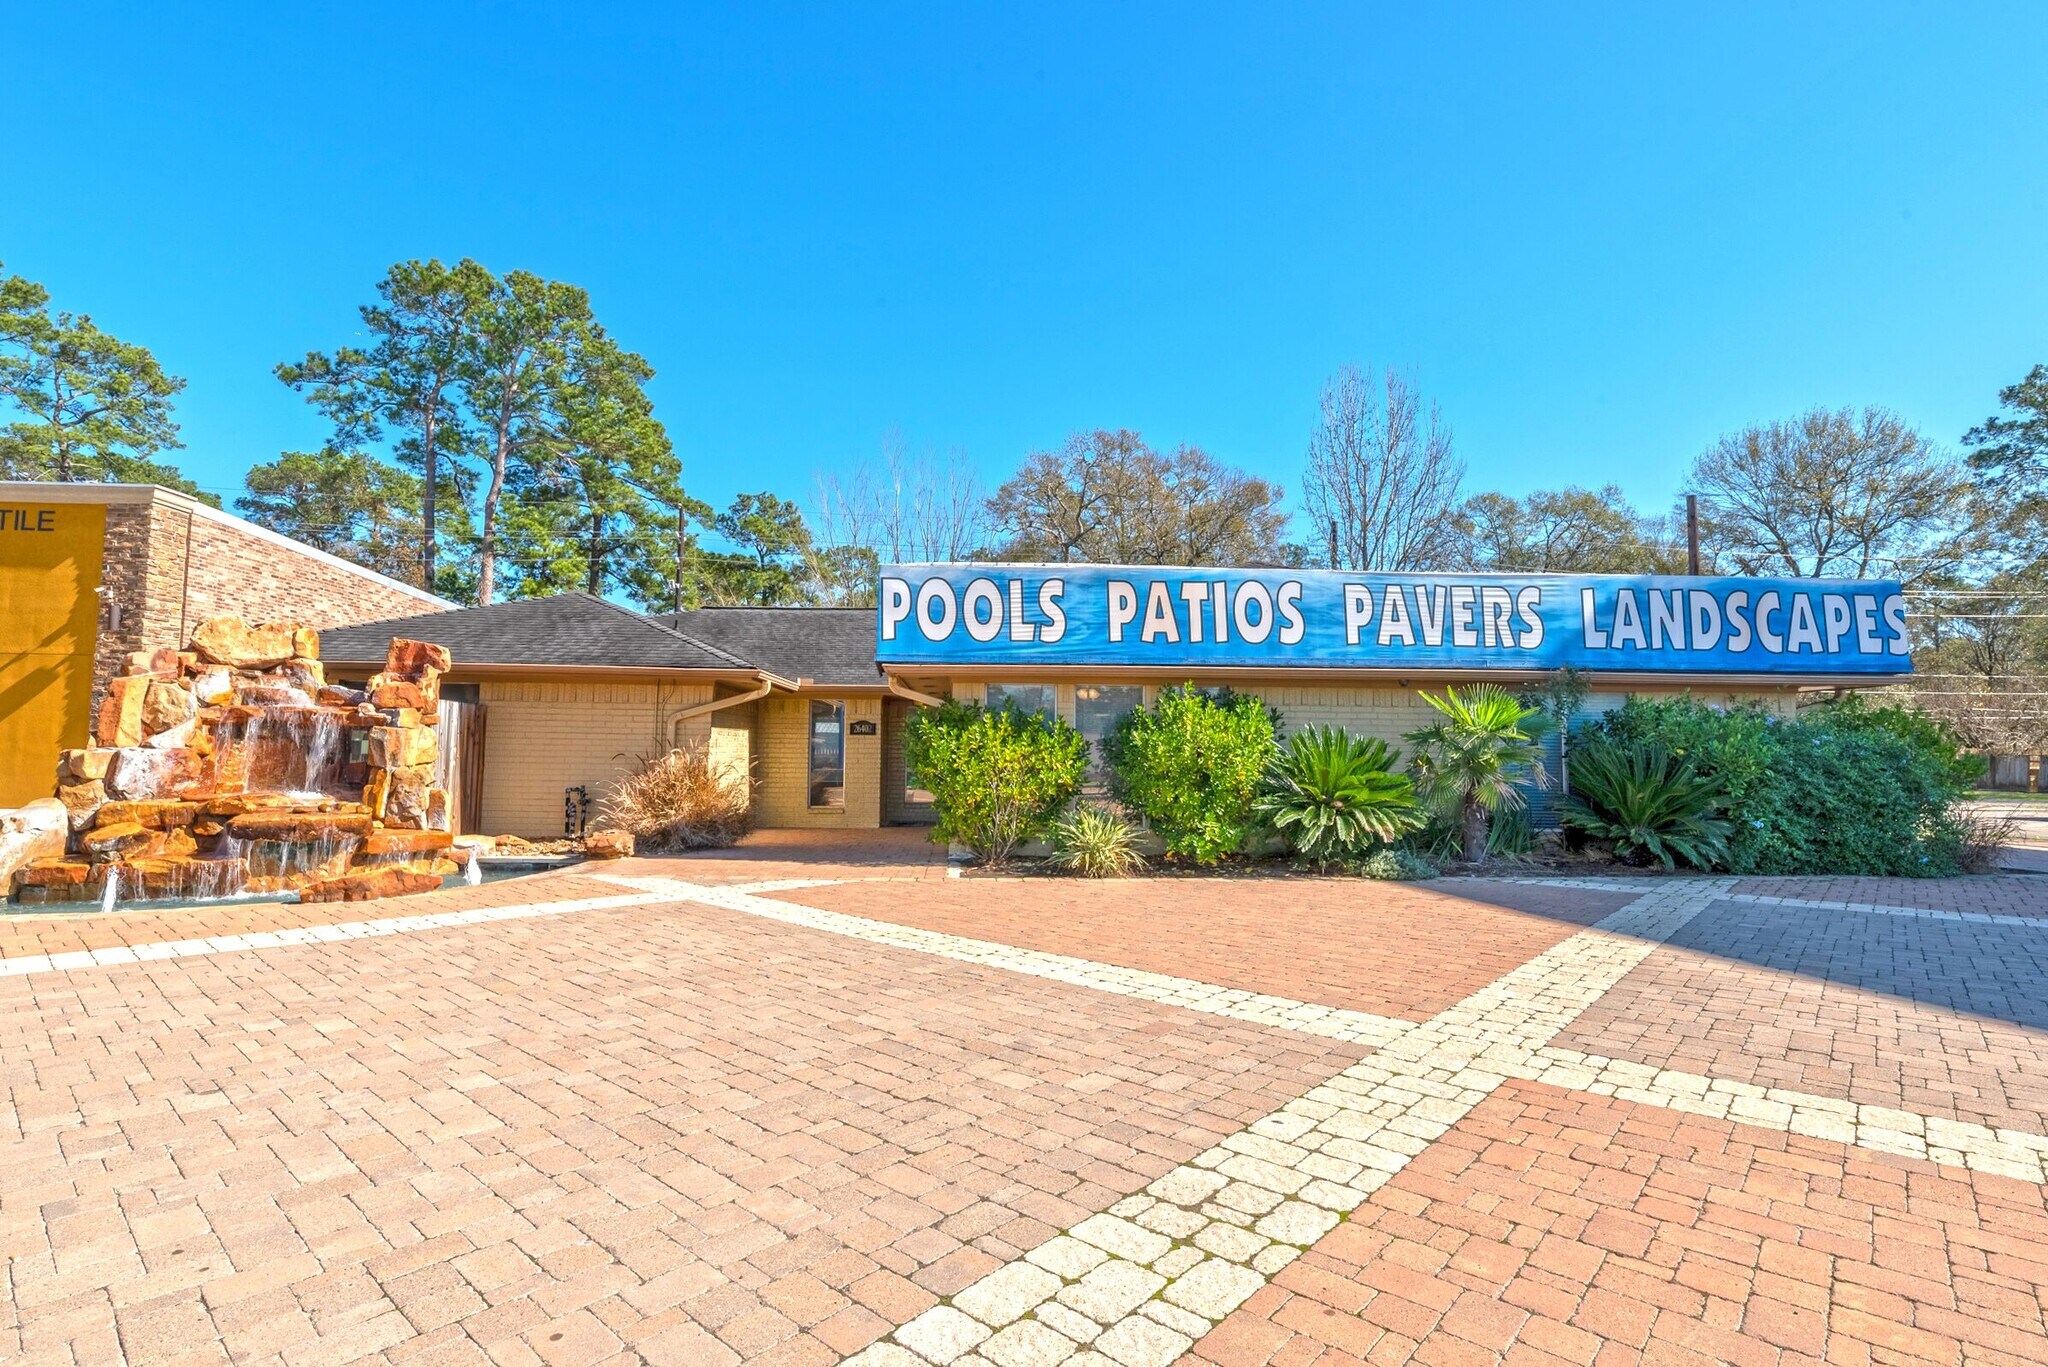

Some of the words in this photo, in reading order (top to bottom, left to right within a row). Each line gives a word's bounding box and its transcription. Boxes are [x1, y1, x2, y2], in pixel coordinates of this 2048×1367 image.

[0, 509, 56, 532] TILE
[880, 577, 1067, 643] POOLS
[1107, 579, 1306, 645] PATIOS
[1343, 583, 1545, 650] PAVERS
[1581, 587, 1909, 656] LANDSCAPES
